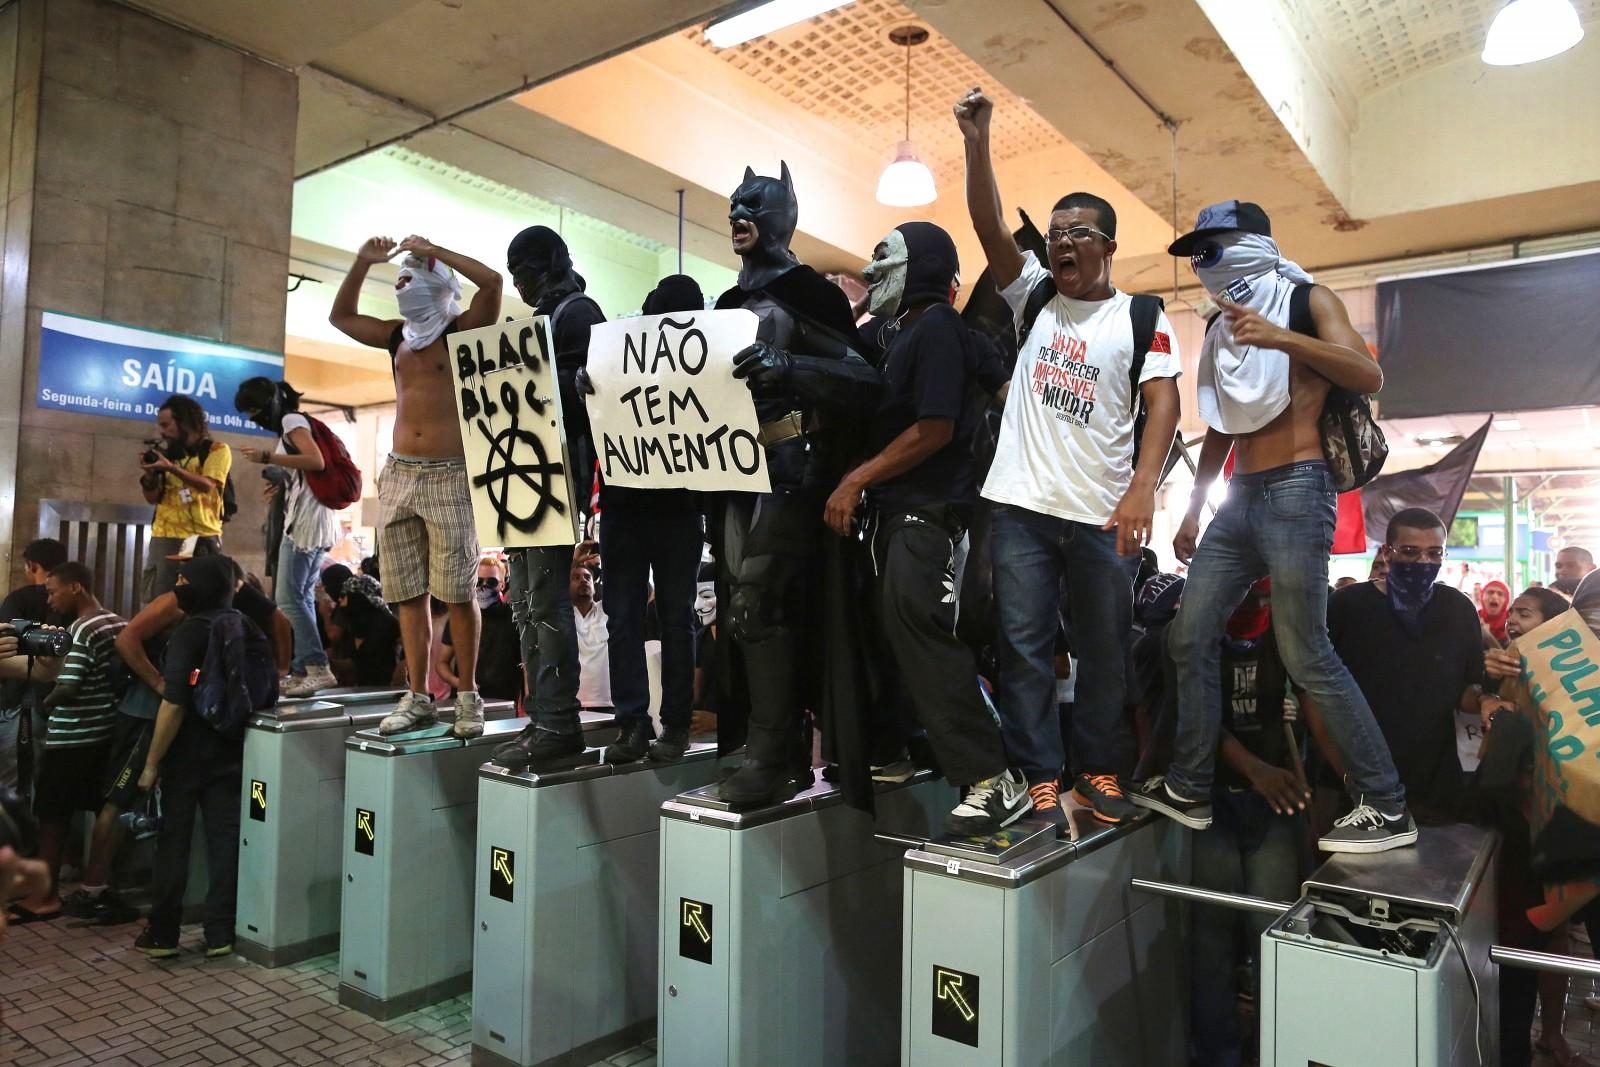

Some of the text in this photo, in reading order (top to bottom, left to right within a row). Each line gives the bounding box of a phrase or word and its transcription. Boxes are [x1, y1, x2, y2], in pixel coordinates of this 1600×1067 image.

[623, 317, 708, 375] NÃO
[122, 358, 217, 399] SAÍDA
[42, 389, 131, 412] Segunda-feira
[135, 403, 142, 413] a
[223, 414, 242, 427] 04h
[620, 385, 709, 427] TEM
[603, 424, 760, 477] AUMENTO
